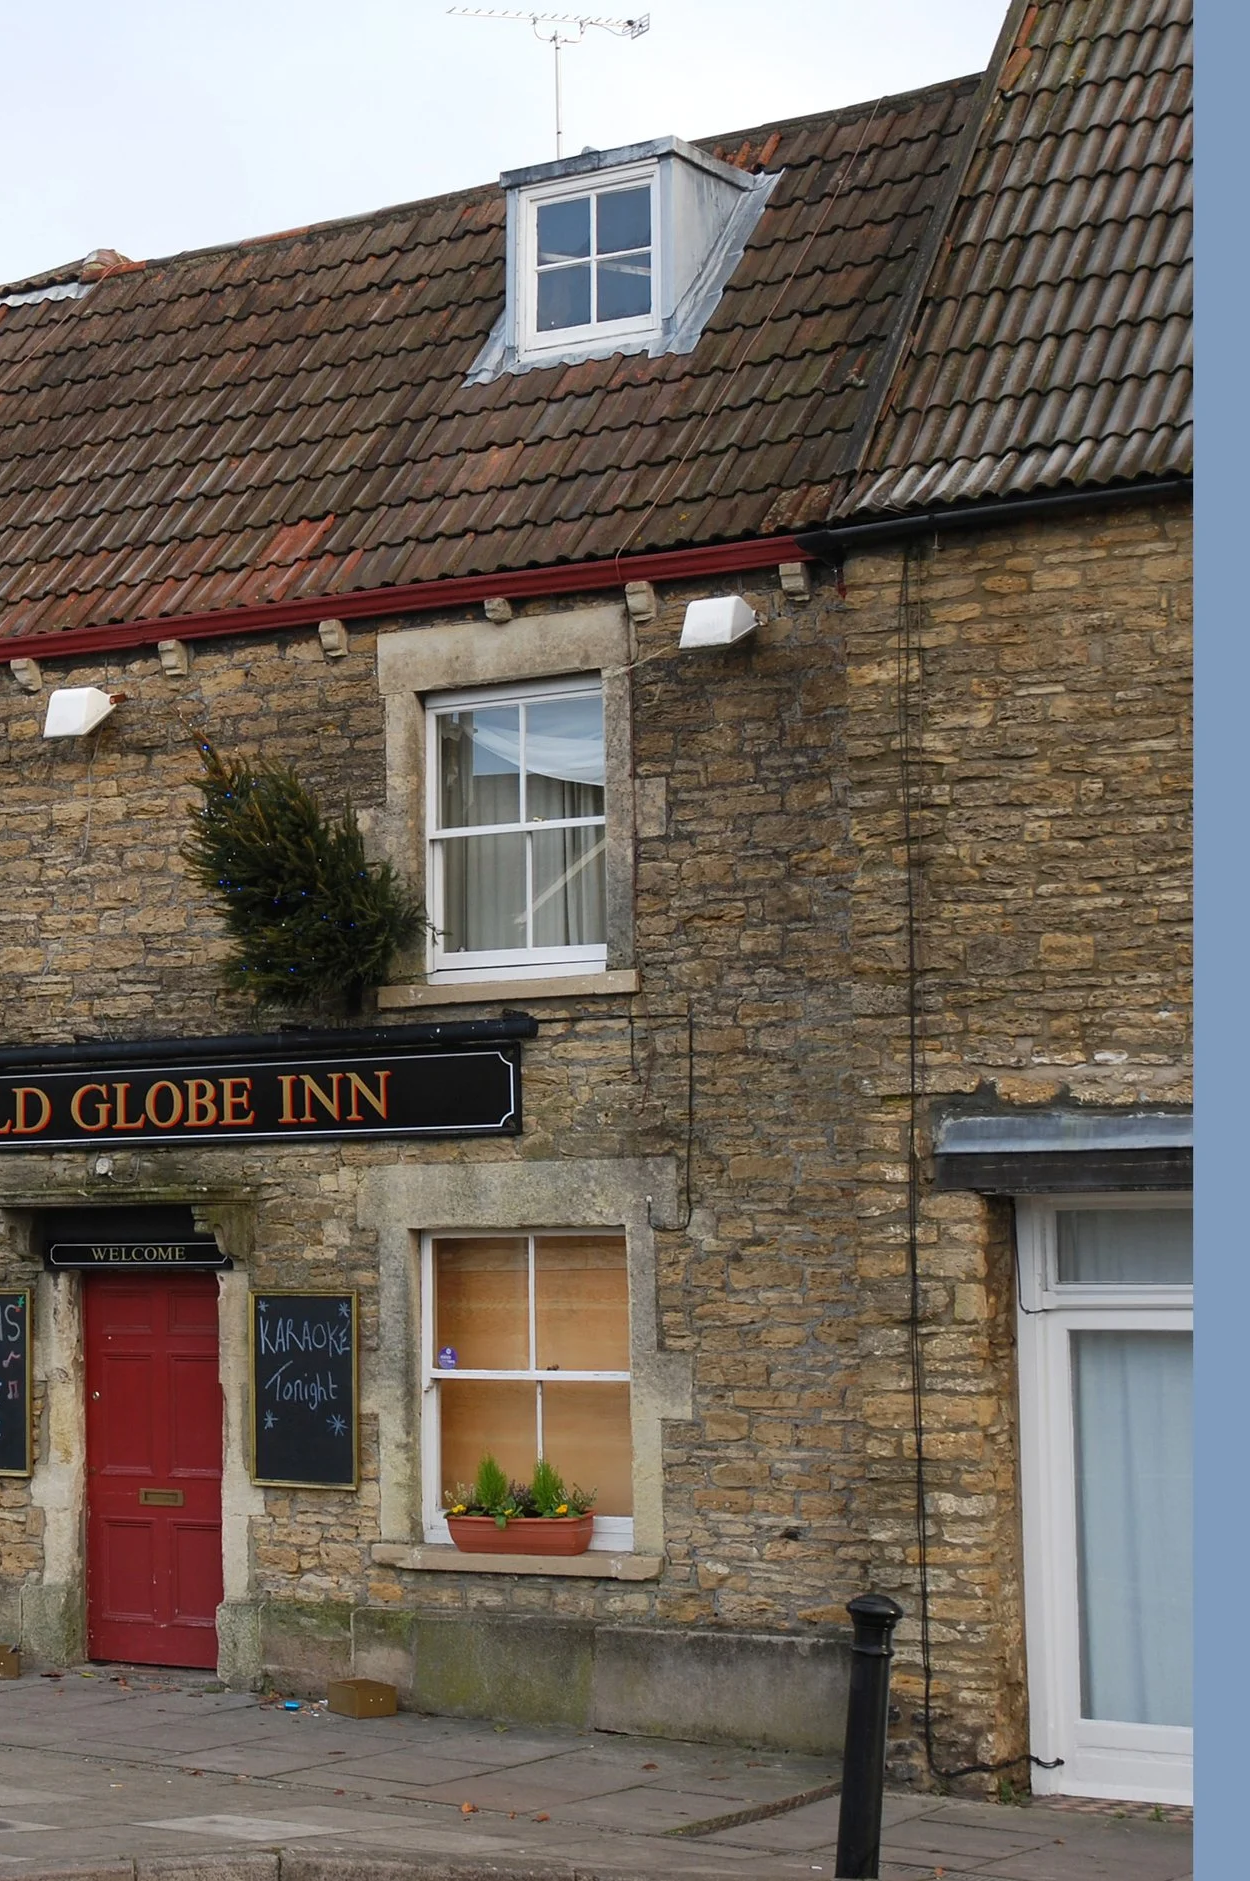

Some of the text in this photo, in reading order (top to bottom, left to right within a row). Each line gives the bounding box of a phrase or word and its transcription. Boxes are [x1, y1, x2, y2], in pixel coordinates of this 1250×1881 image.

[70, 1076, 255, 1132] GLOBE
[276, 1071, 391, 1123] INN
[91, 1246, 186, 1261] WELCOME
[259, 1316, 350, 1357] KARAOKE
[265, 1360, 338, 1410] Tonight
